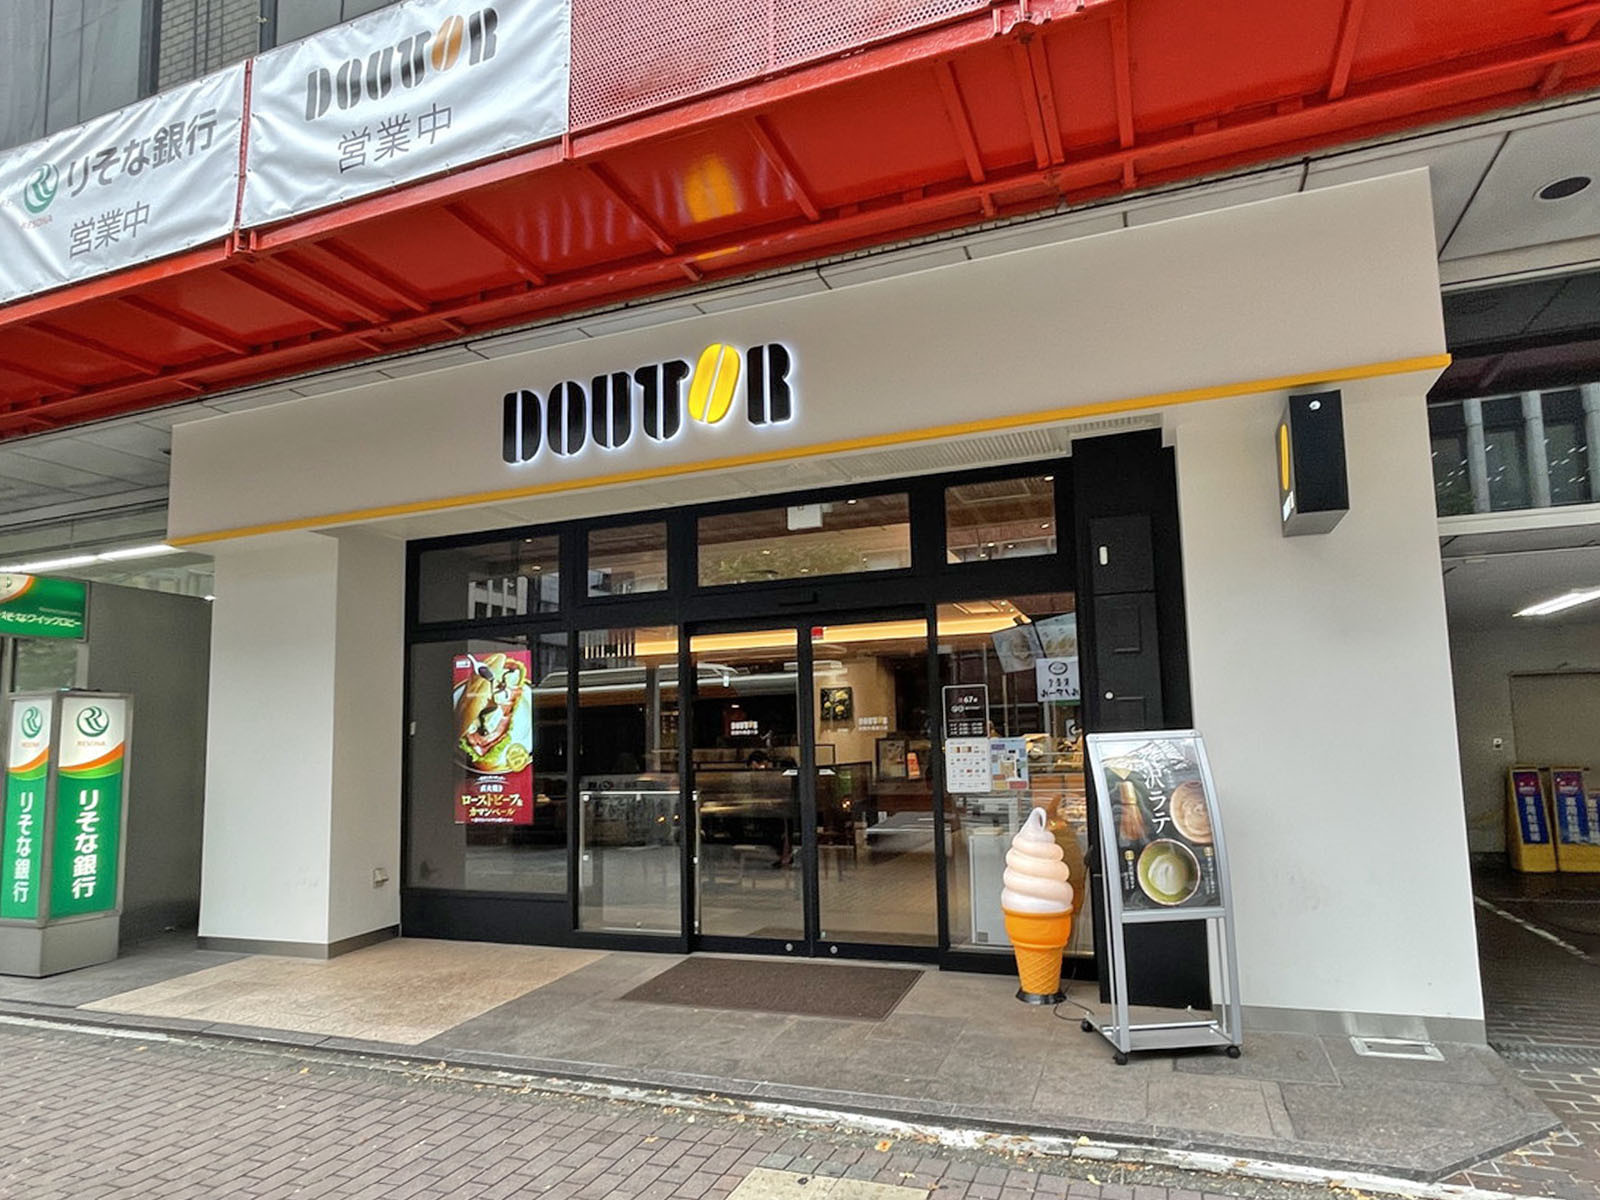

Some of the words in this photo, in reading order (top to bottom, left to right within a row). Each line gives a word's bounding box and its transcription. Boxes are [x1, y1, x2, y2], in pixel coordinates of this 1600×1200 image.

[304, 8, 499, 121] DOUTOR
[68, 110, 218, 197] りそな銀行
[338, 103, 453, 174] 営業中
[69, 200, 151, 258] 営業中
[502, 342, 793, 463] DOUTOR
[13, 791, 34, 903] りそな銀行
[72, 789, 100, 899] りそな銀行
